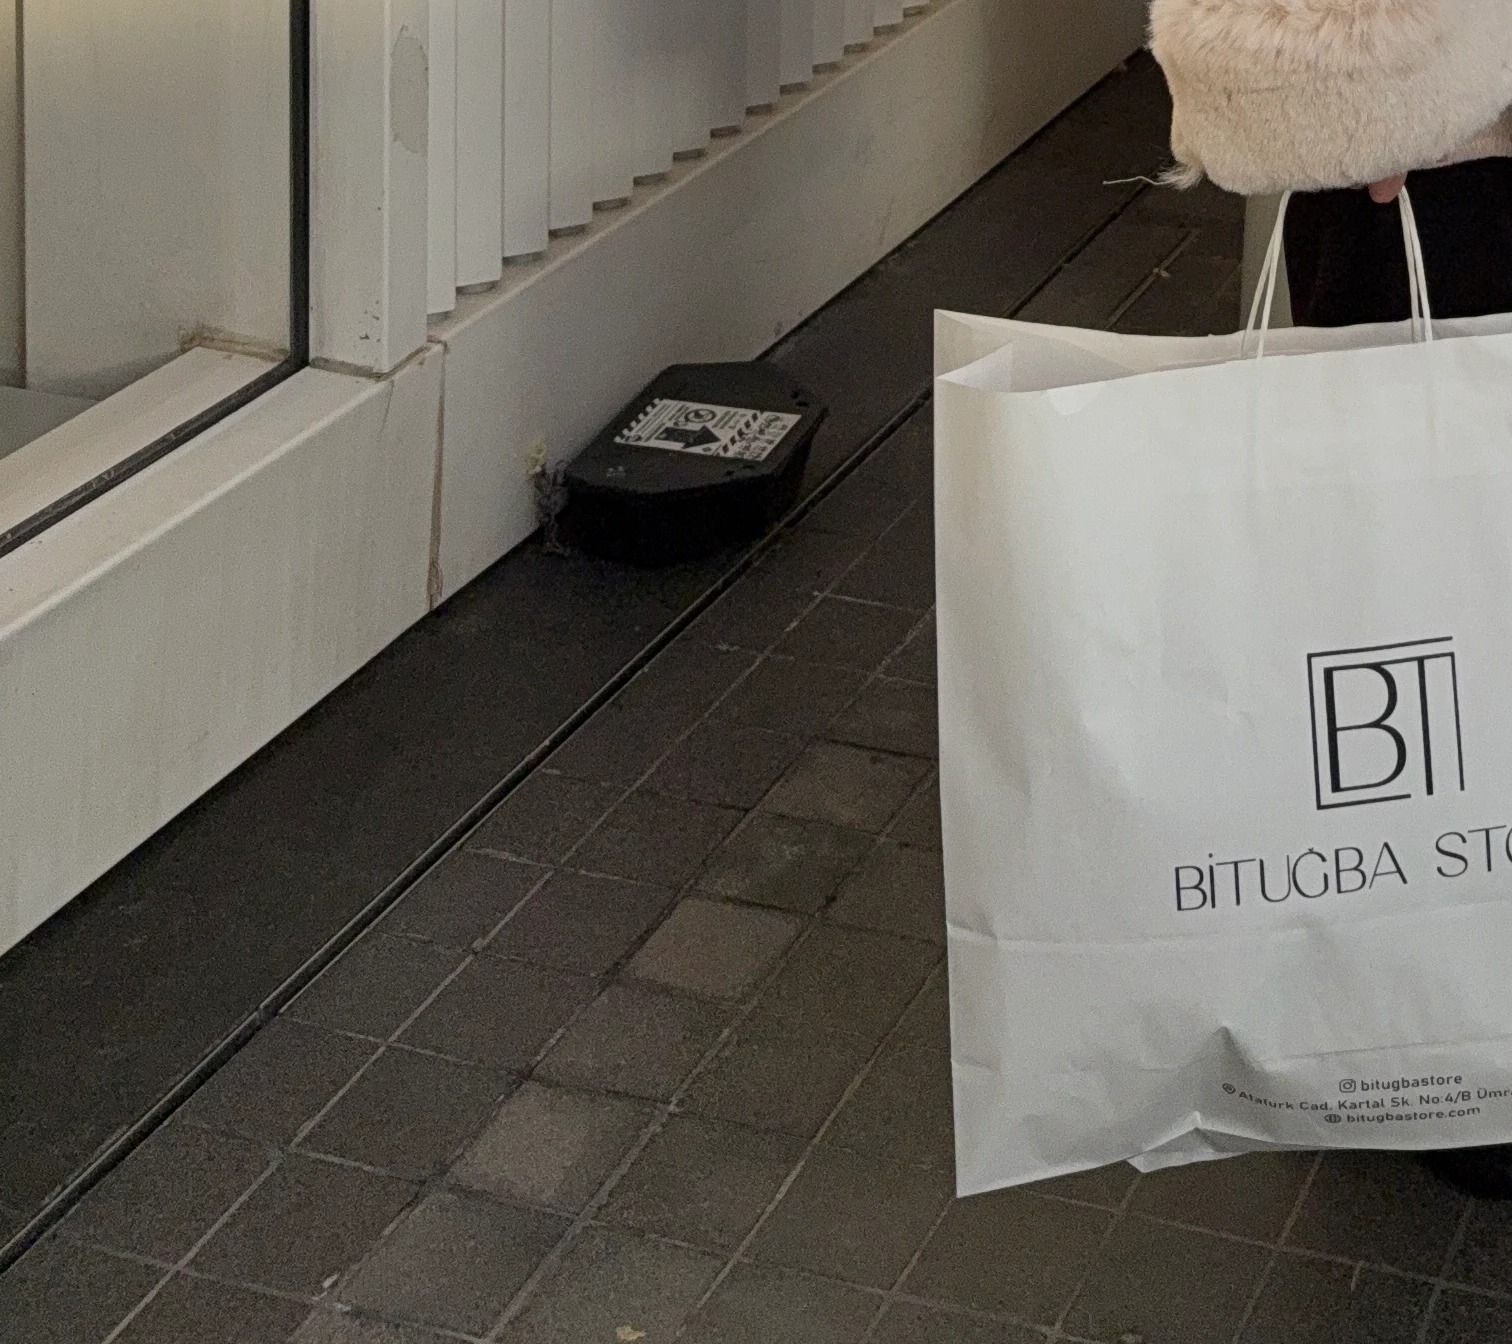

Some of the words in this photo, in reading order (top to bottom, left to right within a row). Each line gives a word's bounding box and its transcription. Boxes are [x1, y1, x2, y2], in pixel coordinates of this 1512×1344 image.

[1360, 1074, 1463, 1092] bitugbastore
[1299, 1100, 1333, 1111] Cad.
[1337, 1097, 1386, 1110] Kartal
[1418, 1089, 1472, 1105] No:4/B
[1346, 1106, 1482, 1124] bitugbastore.com
